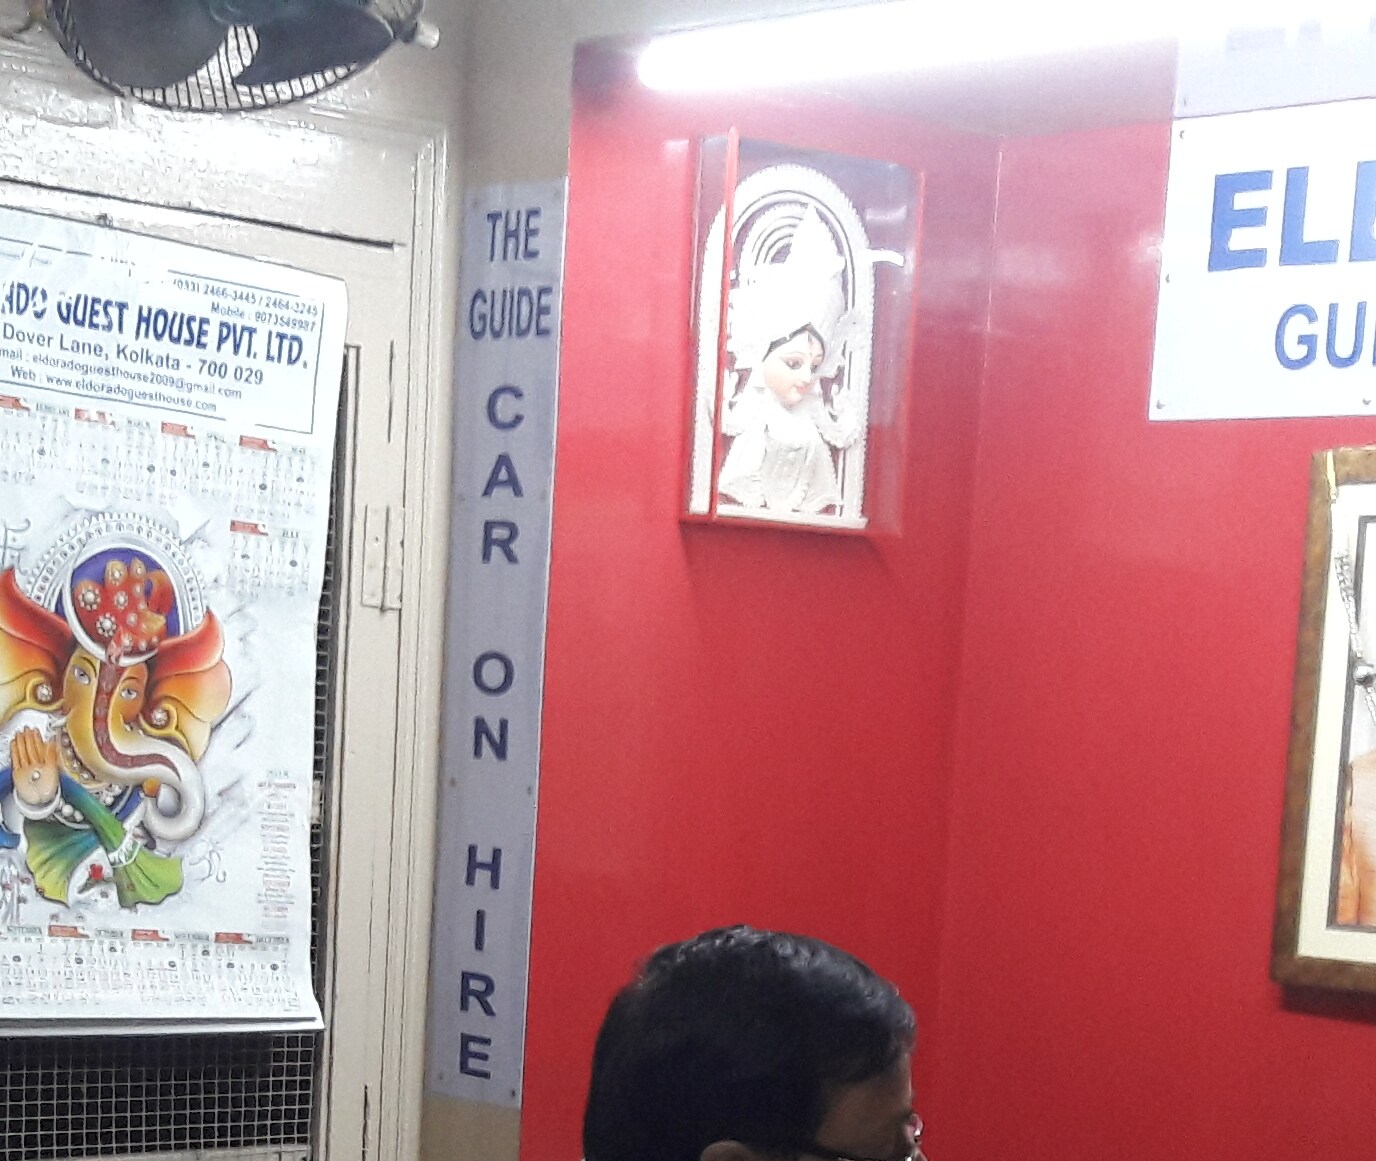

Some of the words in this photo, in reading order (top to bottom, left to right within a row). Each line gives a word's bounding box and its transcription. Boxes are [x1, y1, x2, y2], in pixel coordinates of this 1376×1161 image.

[486, 206, 542, 263] THE
[57, 290, 128, 335] GUEST
[135, 302, 208, 351] HOUSE
[217, 320, 257, 360] PVT.
[266, 330, 309, 369] LTD.
[469, 285, 553, 341] GUIDE
[3, 322, 54, 348] Dover
[59, 333, 110, 361] Lane,
[116, 343, 181, 372] Kolkata
[198, 358, 229, 380] 700
[234, 365, 264, 386] 029
[482, 385, 524, 565] CAR
[472, 650, 515, 762] ON
[459, 844, 503, 1080] HIRE
